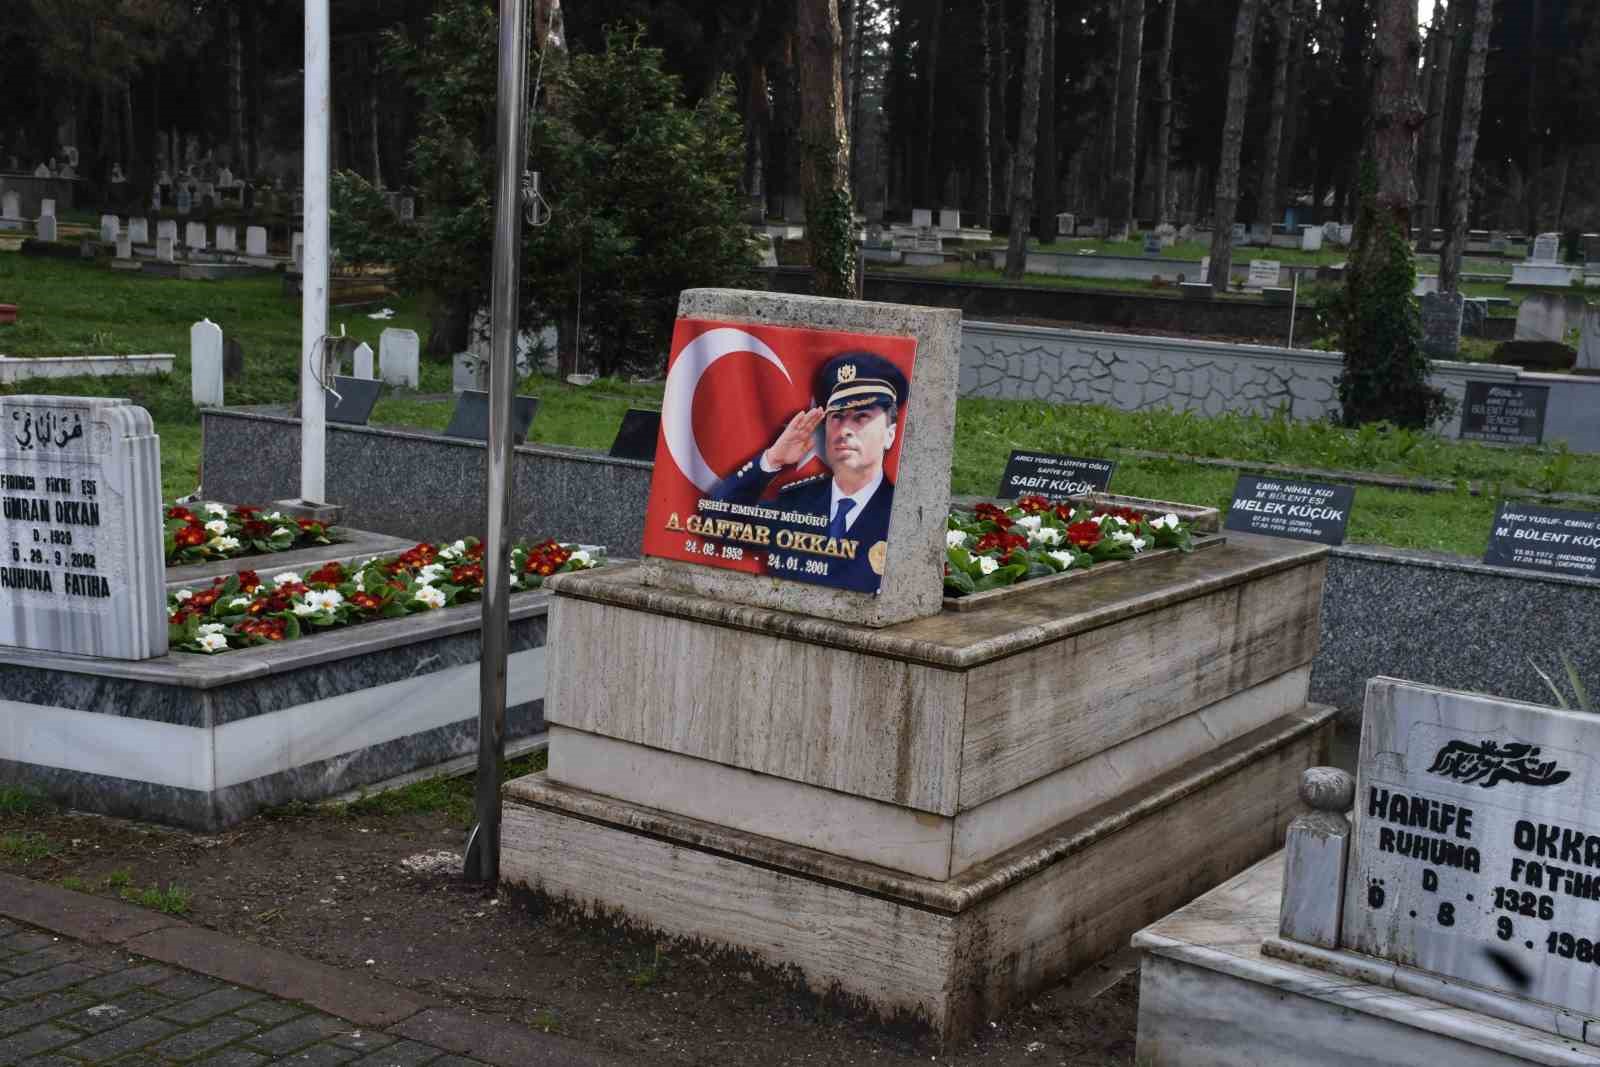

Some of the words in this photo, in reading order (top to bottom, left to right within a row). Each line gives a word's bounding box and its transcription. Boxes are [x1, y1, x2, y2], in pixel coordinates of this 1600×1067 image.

[1010, 475, 1049, 488] SABİT
[1048, 479, 1097, 494] KÜÇÜK
[1283, 483, 1313, 496] NİHAL
[2, 496, 51, 523] ÜMRAN
[55, 500, 100, 526] OKKAN
[698, 498, 731, 512] ŞEHİT
[730, 503, 780, 521] EMNİYET
[780, 510, 830, 528] MÜDÜRÜ
[1232, 498, 1286, 515] MELEK
[1287, 503, 1345, 521] KÜÇÜK
[686, 514, 771, 546] GAFFAR
[775, 528, 860, 560] OKKAN
[1513, 527, 1571, 544] BÜLENT
[0, 566, 53, 593] RUHUNA
[1368, 785, 1474, 840] HANİFE
[1379, 827, 1481, 873] RUHUNA
